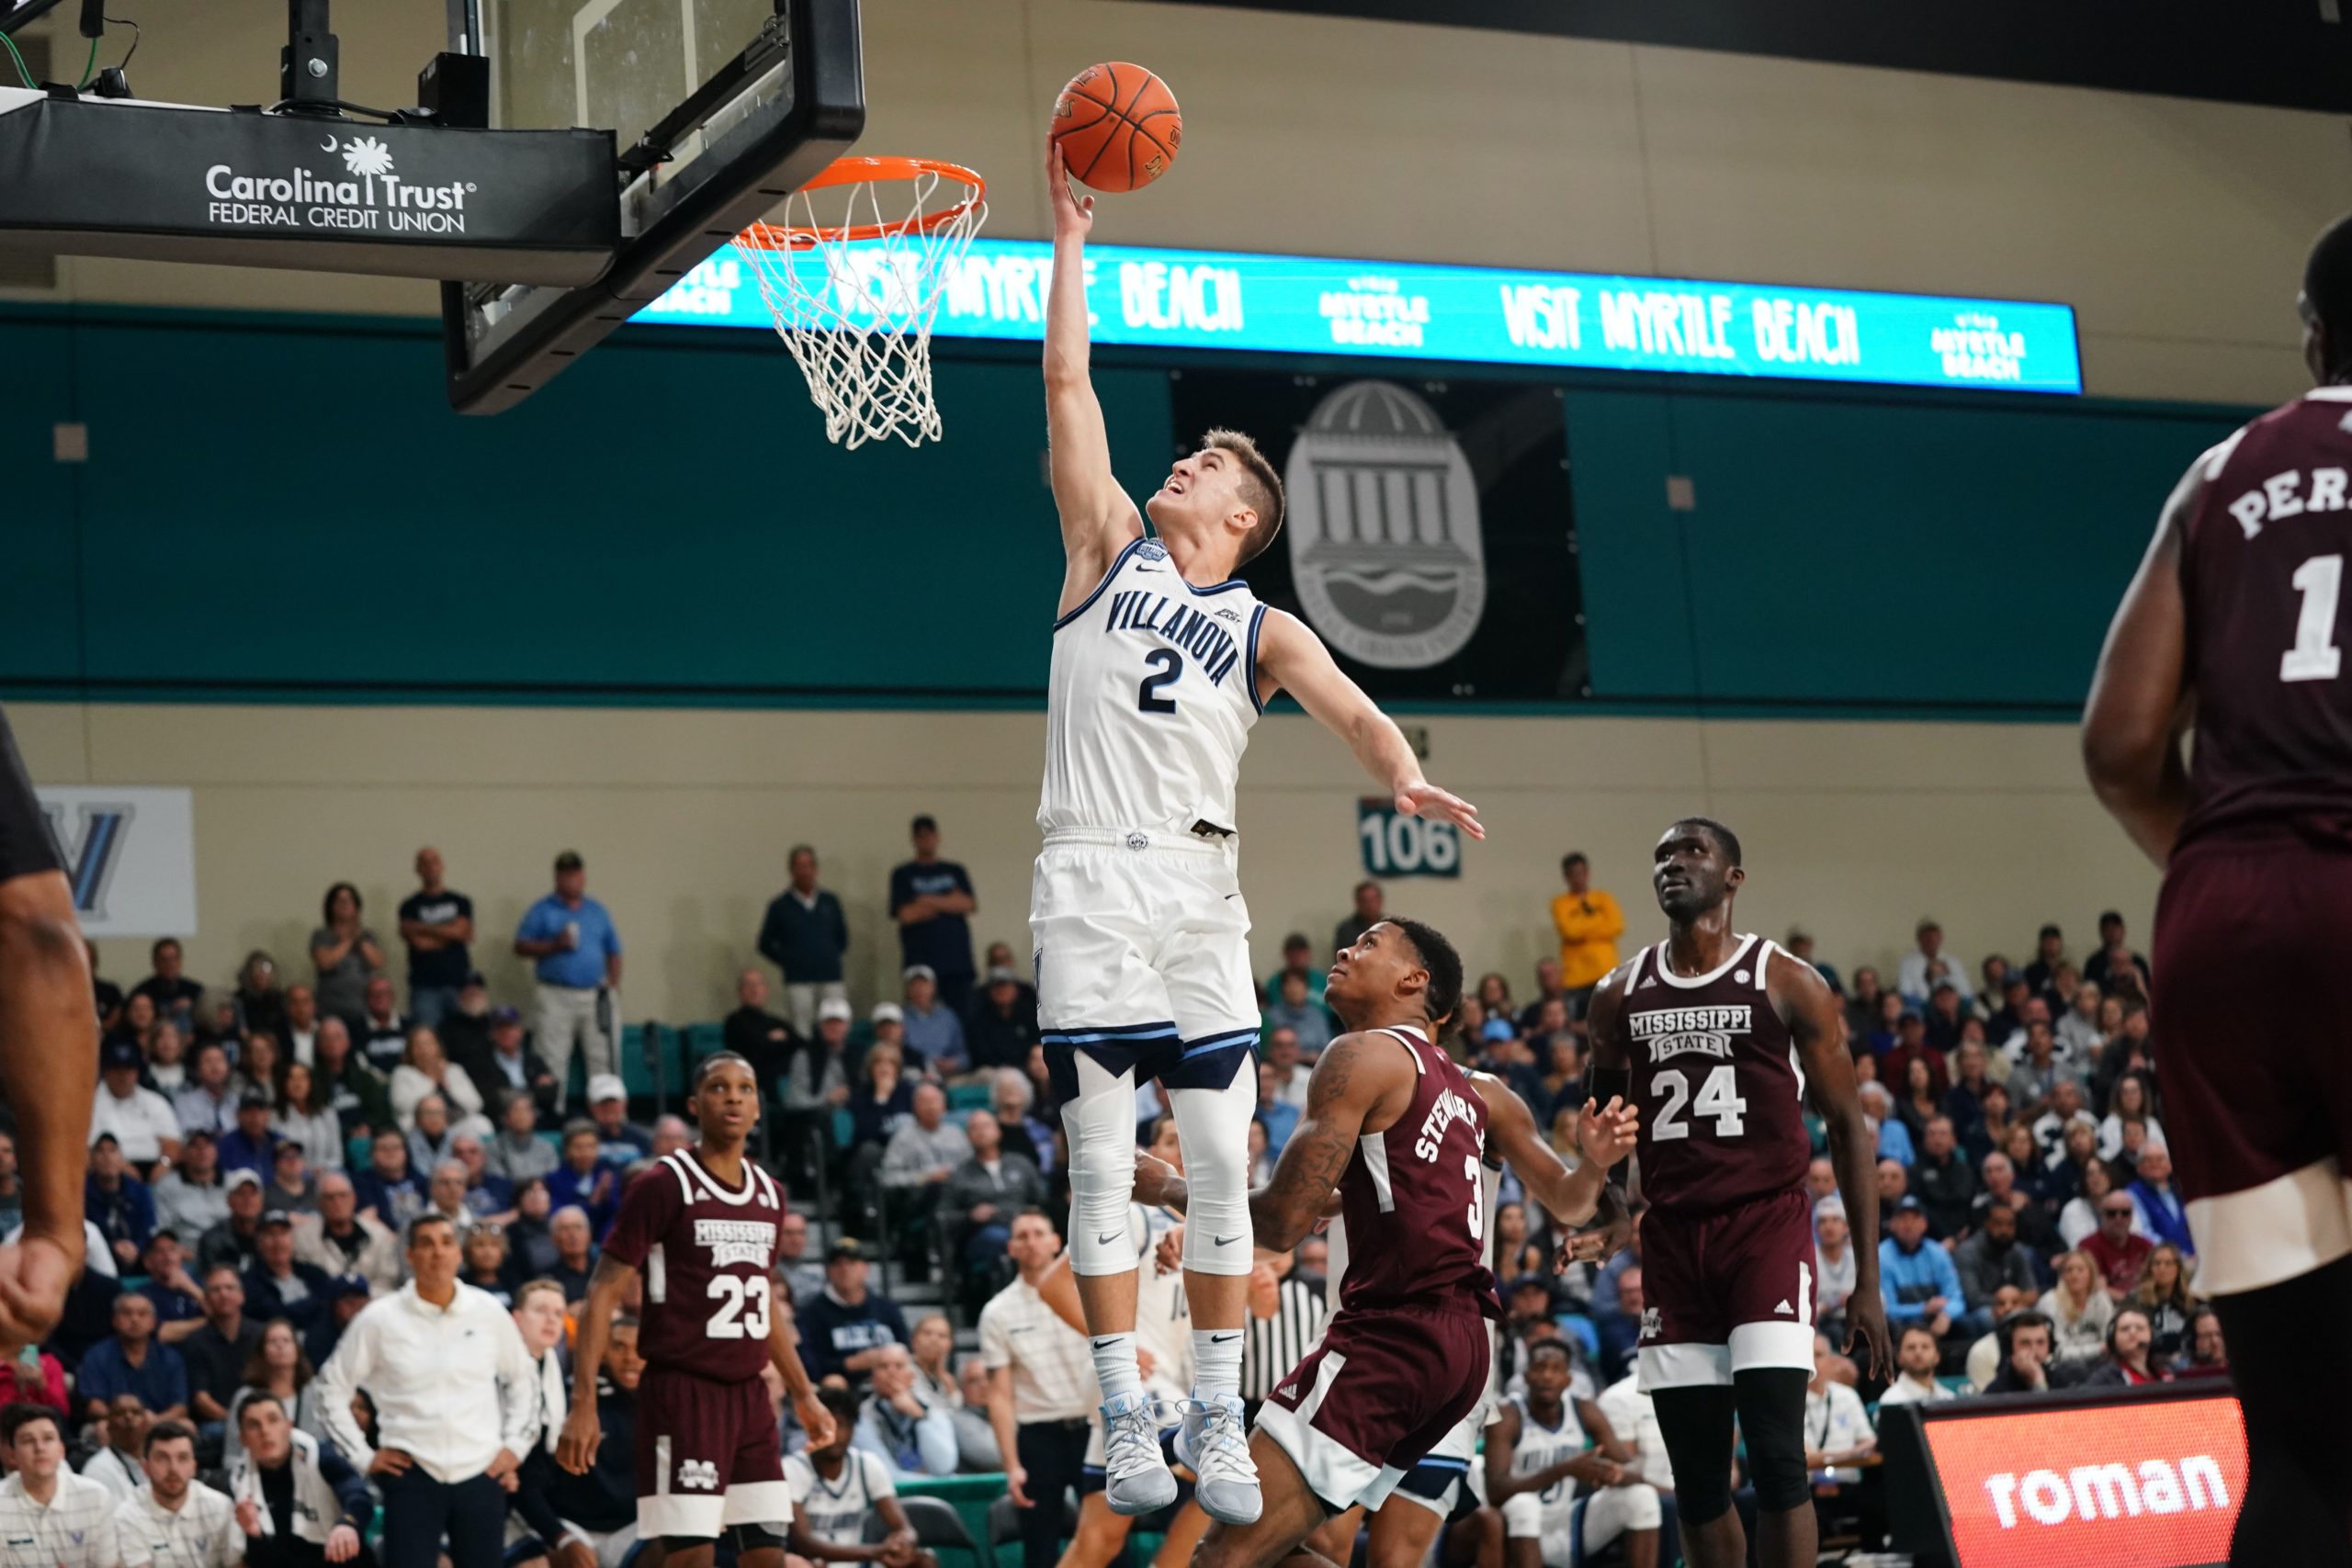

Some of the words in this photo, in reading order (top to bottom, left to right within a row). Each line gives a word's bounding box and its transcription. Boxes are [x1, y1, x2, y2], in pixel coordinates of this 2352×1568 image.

[205, 164, 359, 205] Carolina
[209, 202, 300, 226] FEDERAL
[308, 207, 379, 230] CREDIT
[388, 210, 465, 233] UNION
[944, 254, 1099, 326] MYRTE
[1119, 261, 1243, 332] BEACH
[1499, 283, 1581, 350] VISIT
[1600, 290, 1736, 359] MYRTLE
[1751, 298, 1860, 366] BEACH
[2229, 467, 2352, 540] PER
[1105, 591, 1238, 688] VILLANOVA
[2279, 554, 2343, 682] 1
[1138, 648, 1183, 714] 2
[1360, 813, 1457, 870] 106
[1629, 1009, 1752, 1038] MISSISSIPPI
[1663, 1035, 1717, 1055] STATE
[1650, 1066, 1747, 1141] 24
[1464, 1155, 1485, 1240] 3
[706, 1274, 771, 1340] 23
[1984, 1454, 2231, 1529] roman
